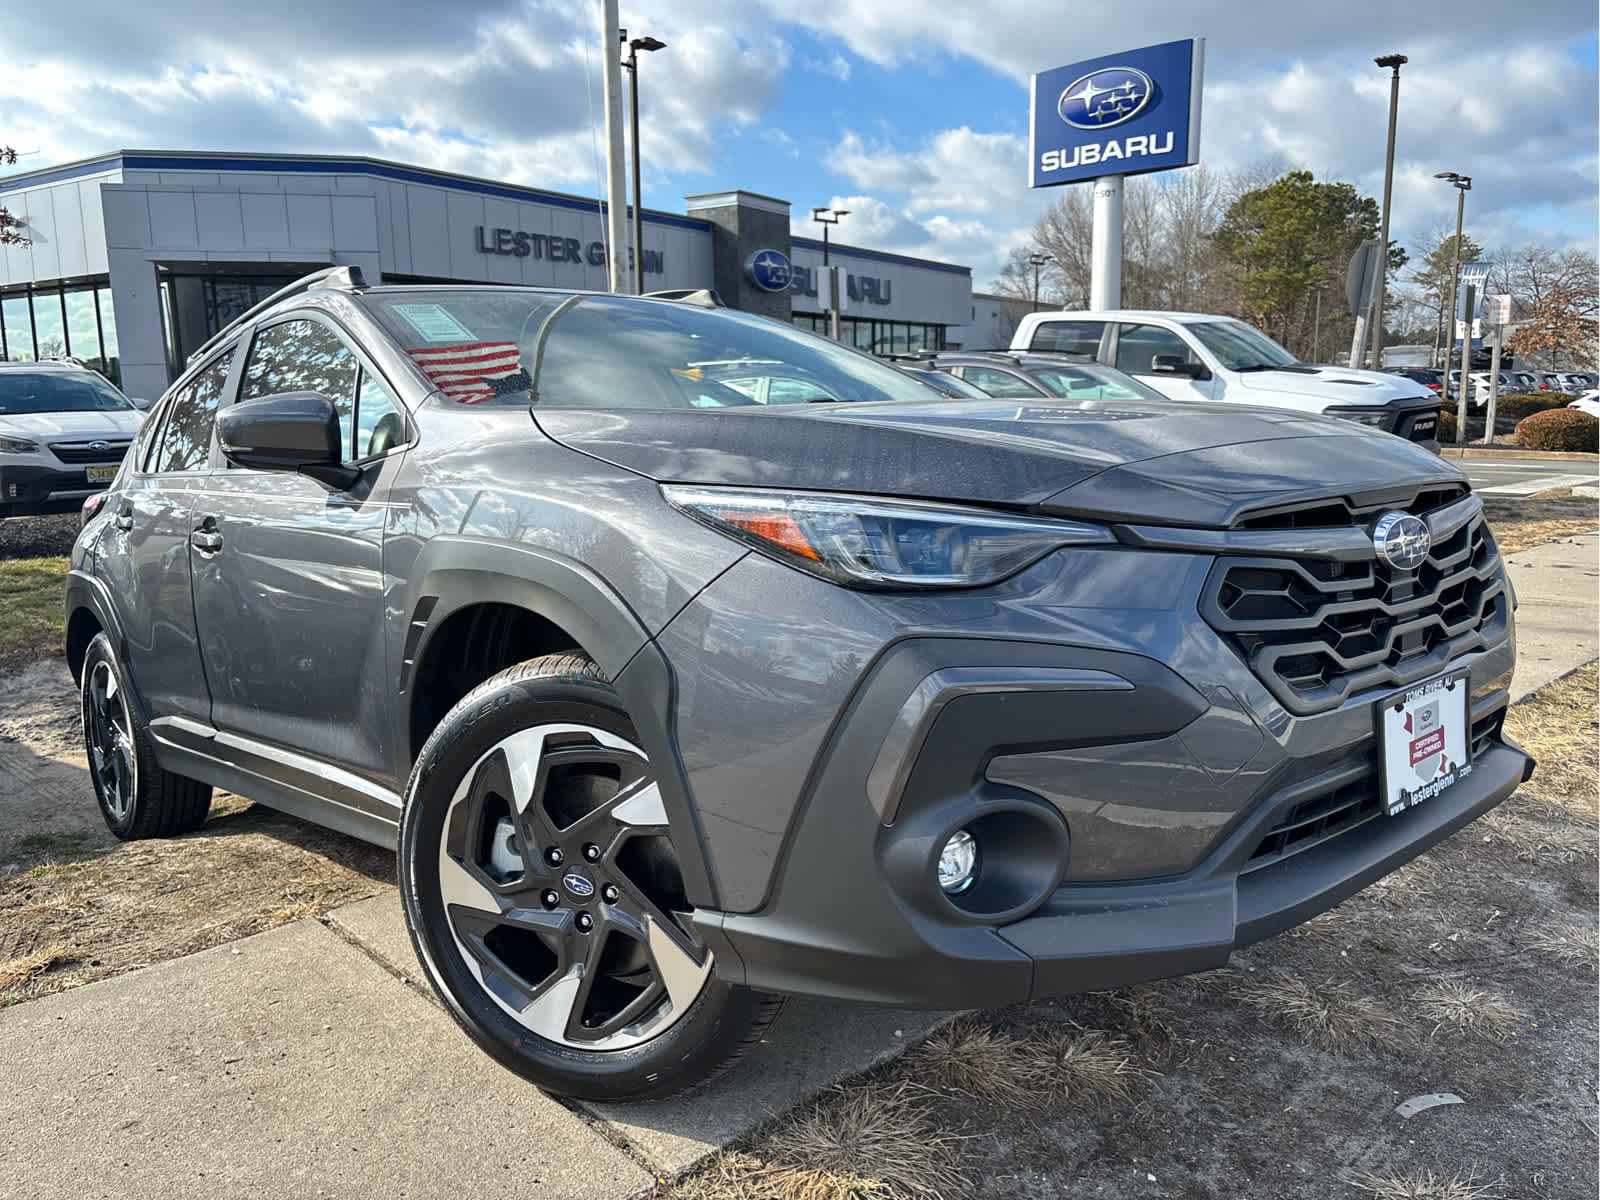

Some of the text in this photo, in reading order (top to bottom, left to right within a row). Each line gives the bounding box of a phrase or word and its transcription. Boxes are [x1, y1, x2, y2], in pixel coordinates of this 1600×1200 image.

[1041, 131, 1174, 172] SUBARU
[475, 226, 582, 264] LESTER
[1410, 774, 1455, 806] lesterglenn
